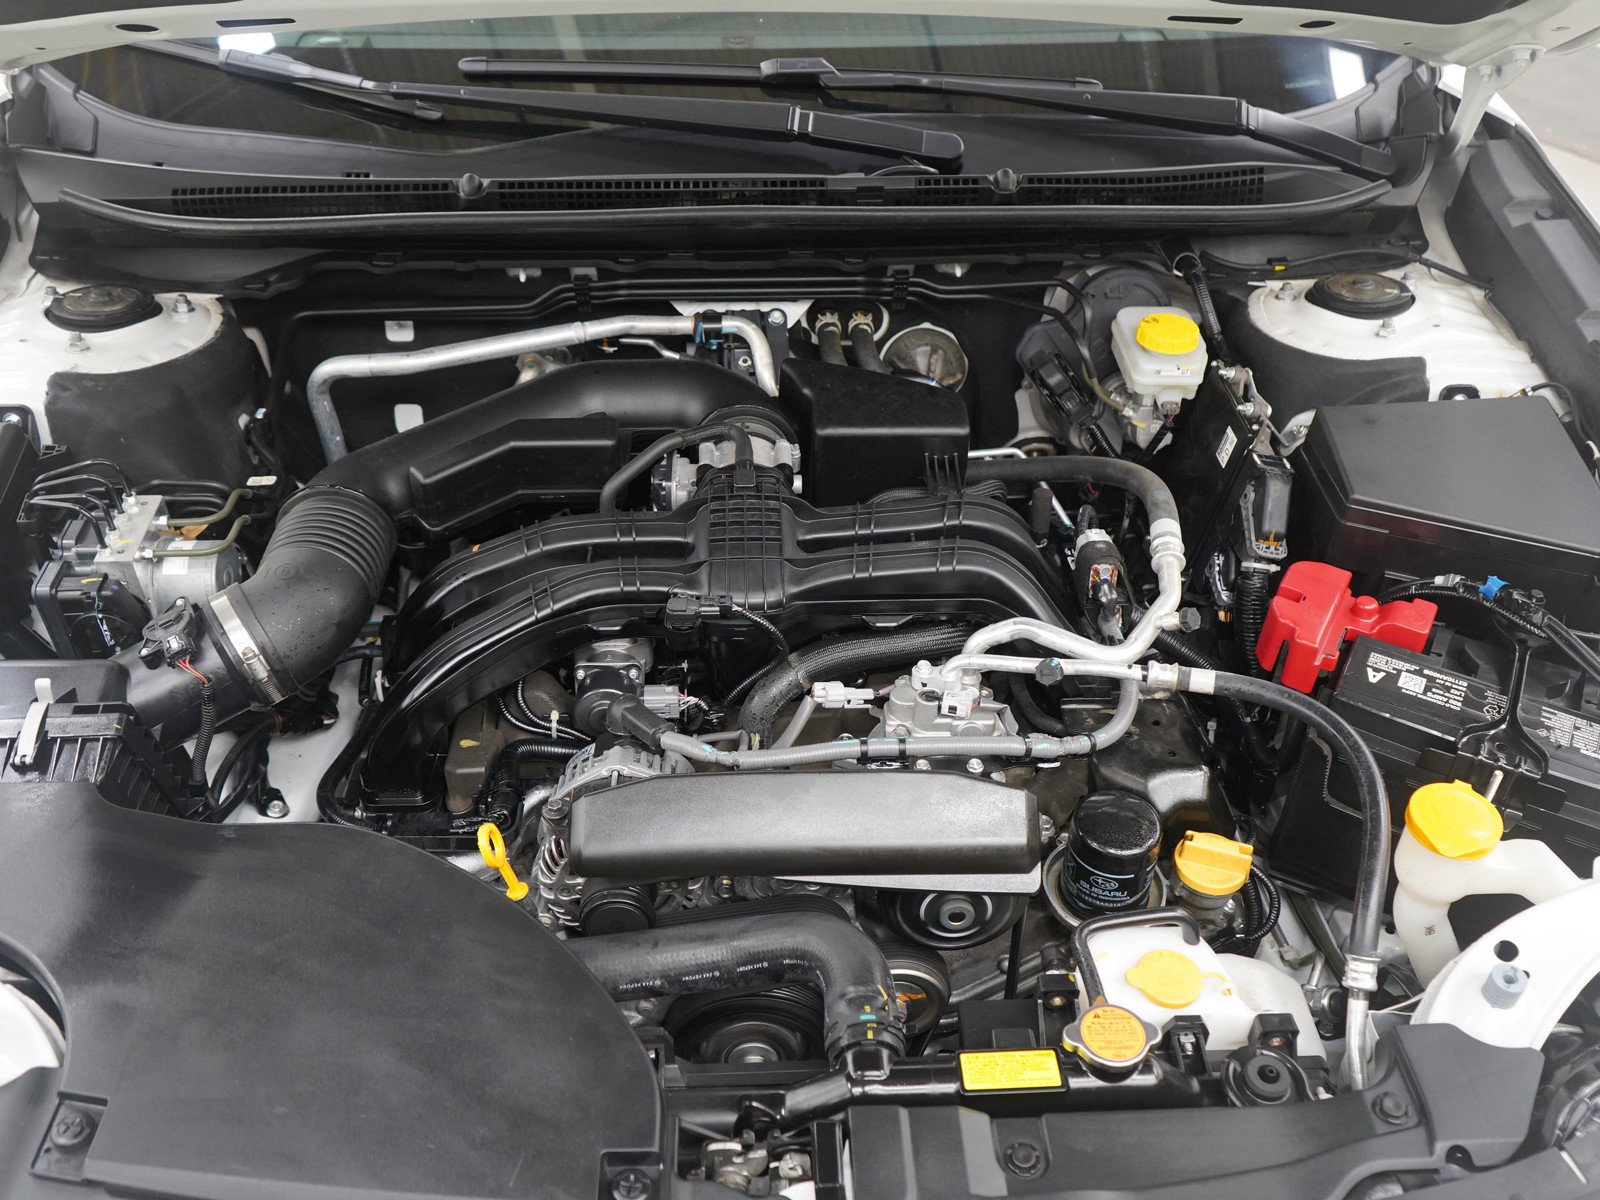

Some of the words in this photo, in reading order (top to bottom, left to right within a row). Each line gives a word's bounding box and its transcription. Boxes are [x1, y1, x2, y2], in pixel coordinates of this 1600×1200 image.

[1417, 693, 1445, 706] CRANKING
[1426, 691, 1448, 702] AMPS
[1080, 880, 1127, 897] SUBARU
